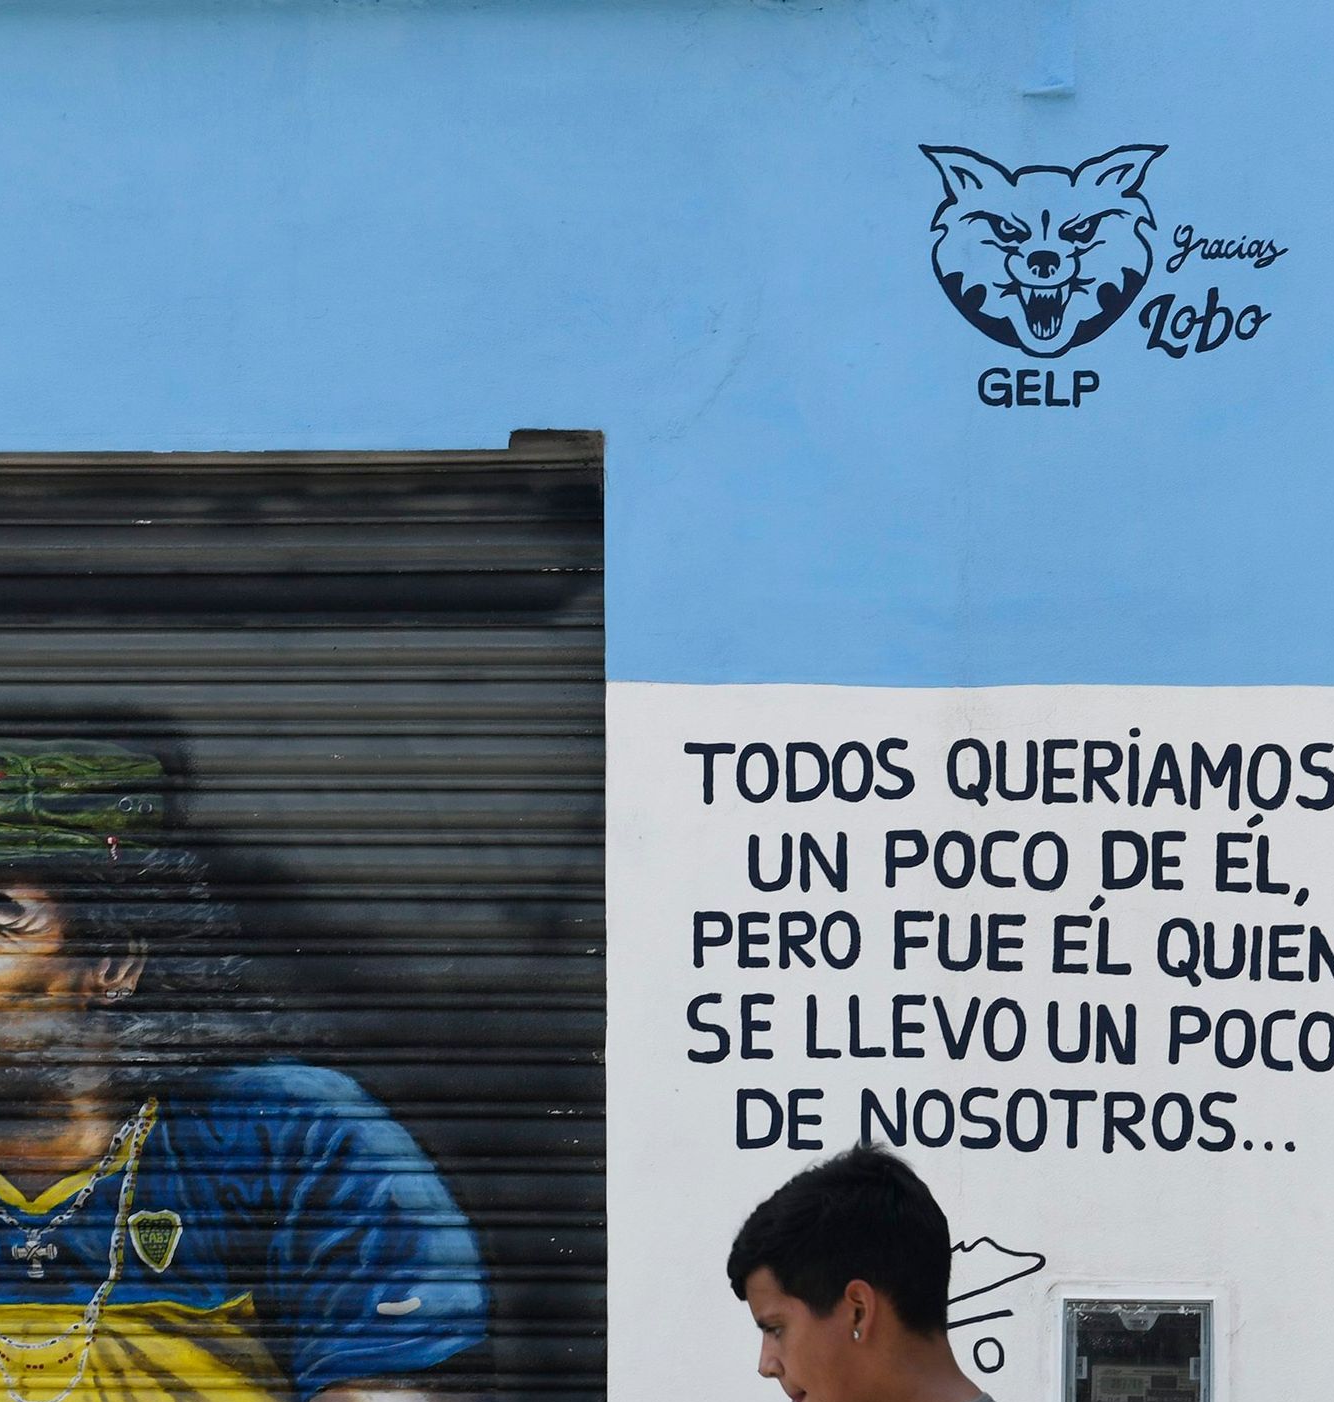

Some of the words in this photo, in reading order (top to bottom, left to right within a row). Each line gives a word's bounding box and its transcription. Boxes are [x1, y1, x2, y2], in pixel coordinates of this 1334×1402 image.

[1139, 287, 1271, 358] Lobo
[978, 368, 1099, 408] GELP
[684, 738, 915, 804] TODOS
[748, 832, 847, 892] UN
[886, 830, 1068, 891] POCO
[1102, 830, 1186, 890] DE
[1216, 814, 1309, 906] ÉL,
[693, 911, 861, 969] PERO
[894, 910, 1026, 972] FUE
[1053, 895, 1131, 975] ÉL
[687, 993, 774, 1064] SE
[807, 995, 1026, 1061] LLEVO
[1047, 1001, 1136, 1065] UN
[737, 1089, 824, 1150] DE
[860, 1087, 1295, 1154] NOSOTROS...
